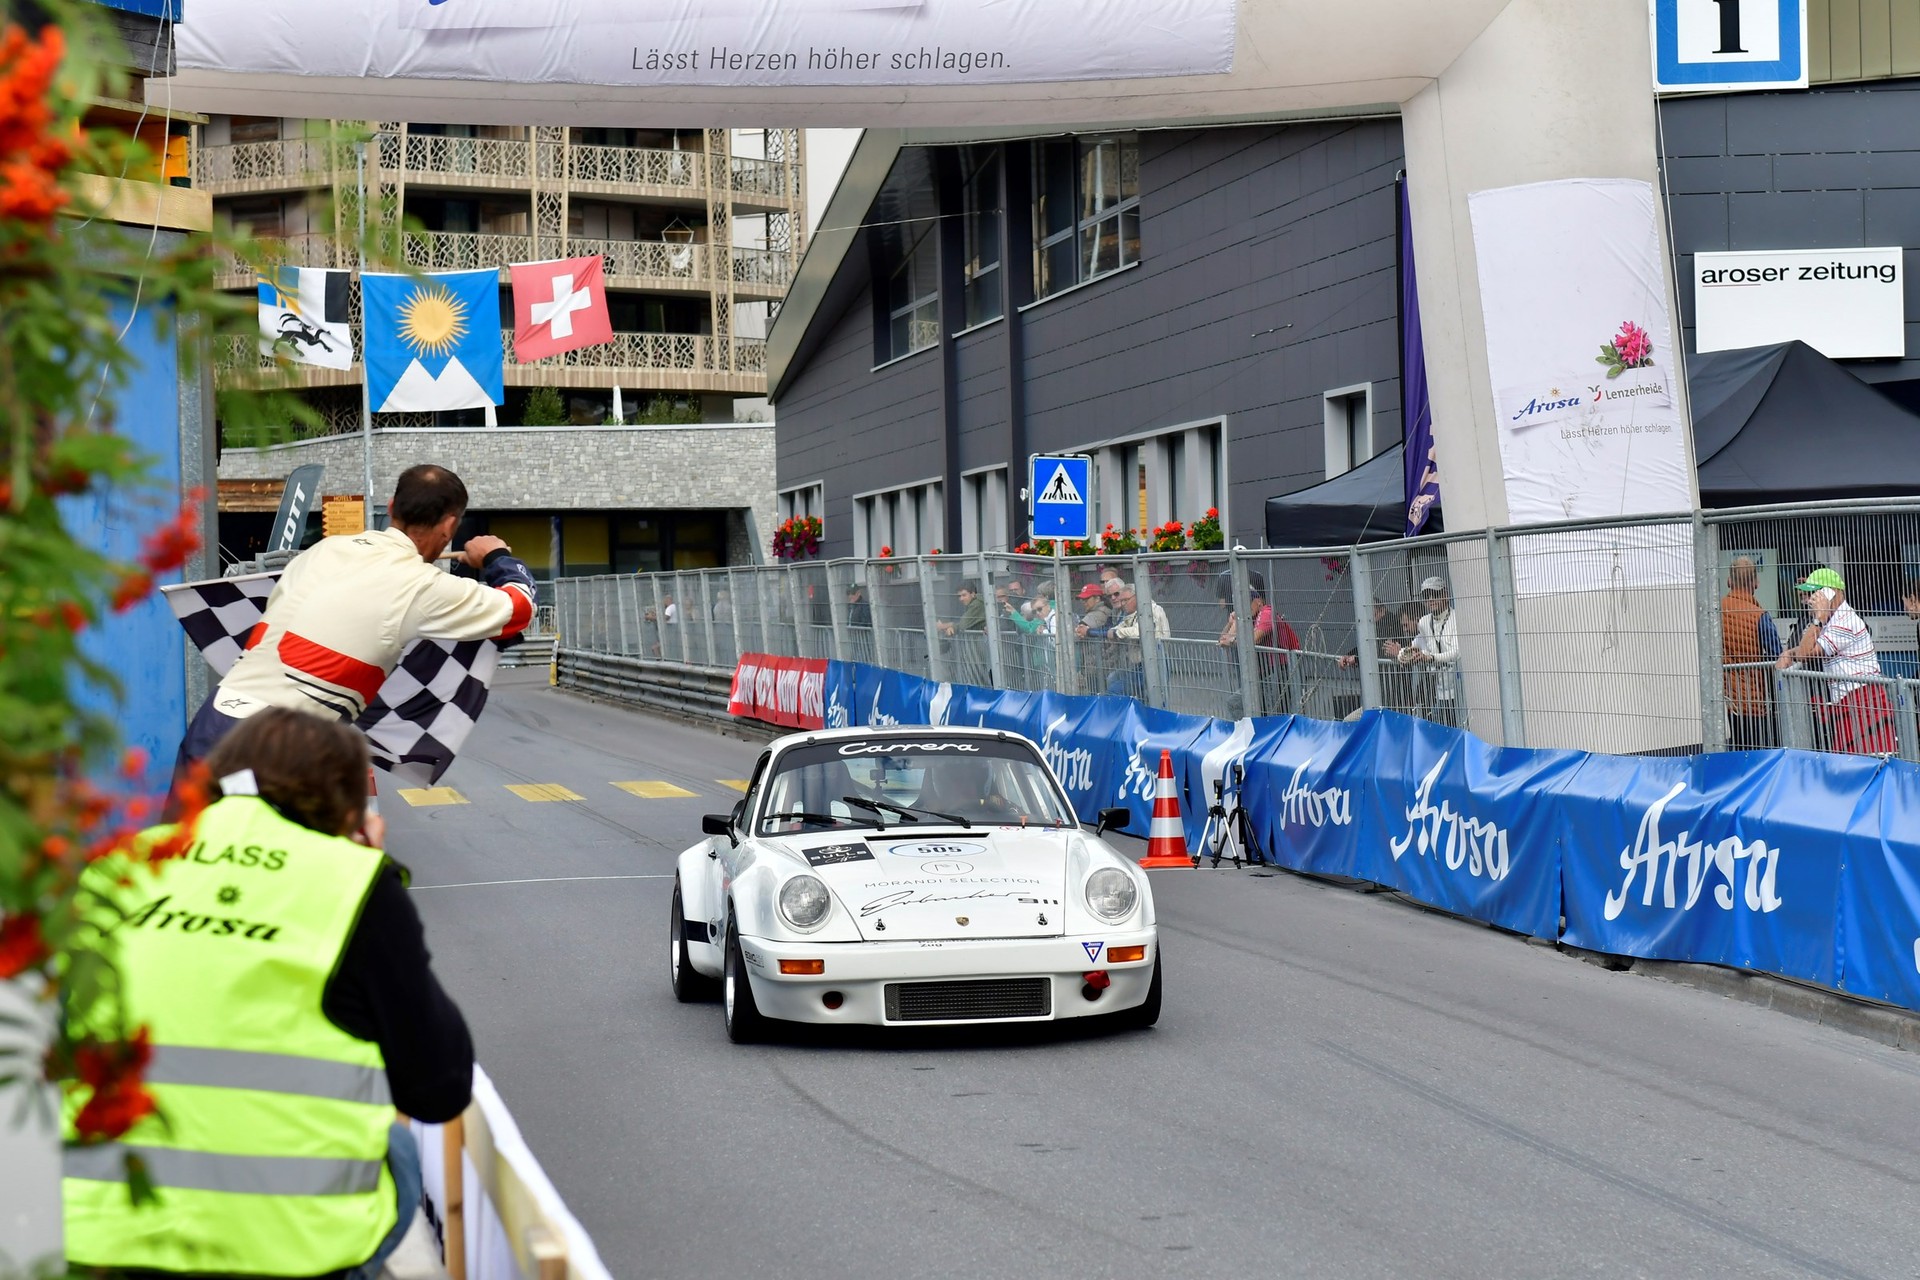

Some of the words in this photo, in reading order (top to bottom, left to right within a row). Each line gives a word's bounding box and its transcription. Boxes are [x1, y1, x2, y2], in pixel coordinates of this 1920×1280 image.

[1712, 0, 1749, 54] i
[631, 46, 700, 71] Lässt
[709, 46, 798, 71] Herzen
[808, 45, 882, 71] höher
[890, 46, 1012, 74] schlagen.
[1701, 266, 1790, 284] aroser
[1798, 261, 1897, 284] zeitung
[1604, 383, 1664, 401] Lenzerheide
[1512, 395, 1582, 421] Arosa
[1560, 427, 1586, 440] Lässt
[1587, 425, 1619, 437] Herzen
[1620, 422, 1643, 434] höher
[838, 741, 980, 756] Carrera
[1280, 757, 1352, 831] Arosa
[1389, 751, 1511, 882] Arosa
[917, 846, 962, 854] 505
[1603, 781, 1783, 921] Arosa
[864, 878, 943, 889] MORANDI
[949, 876, 1041, 886] SELECTION
